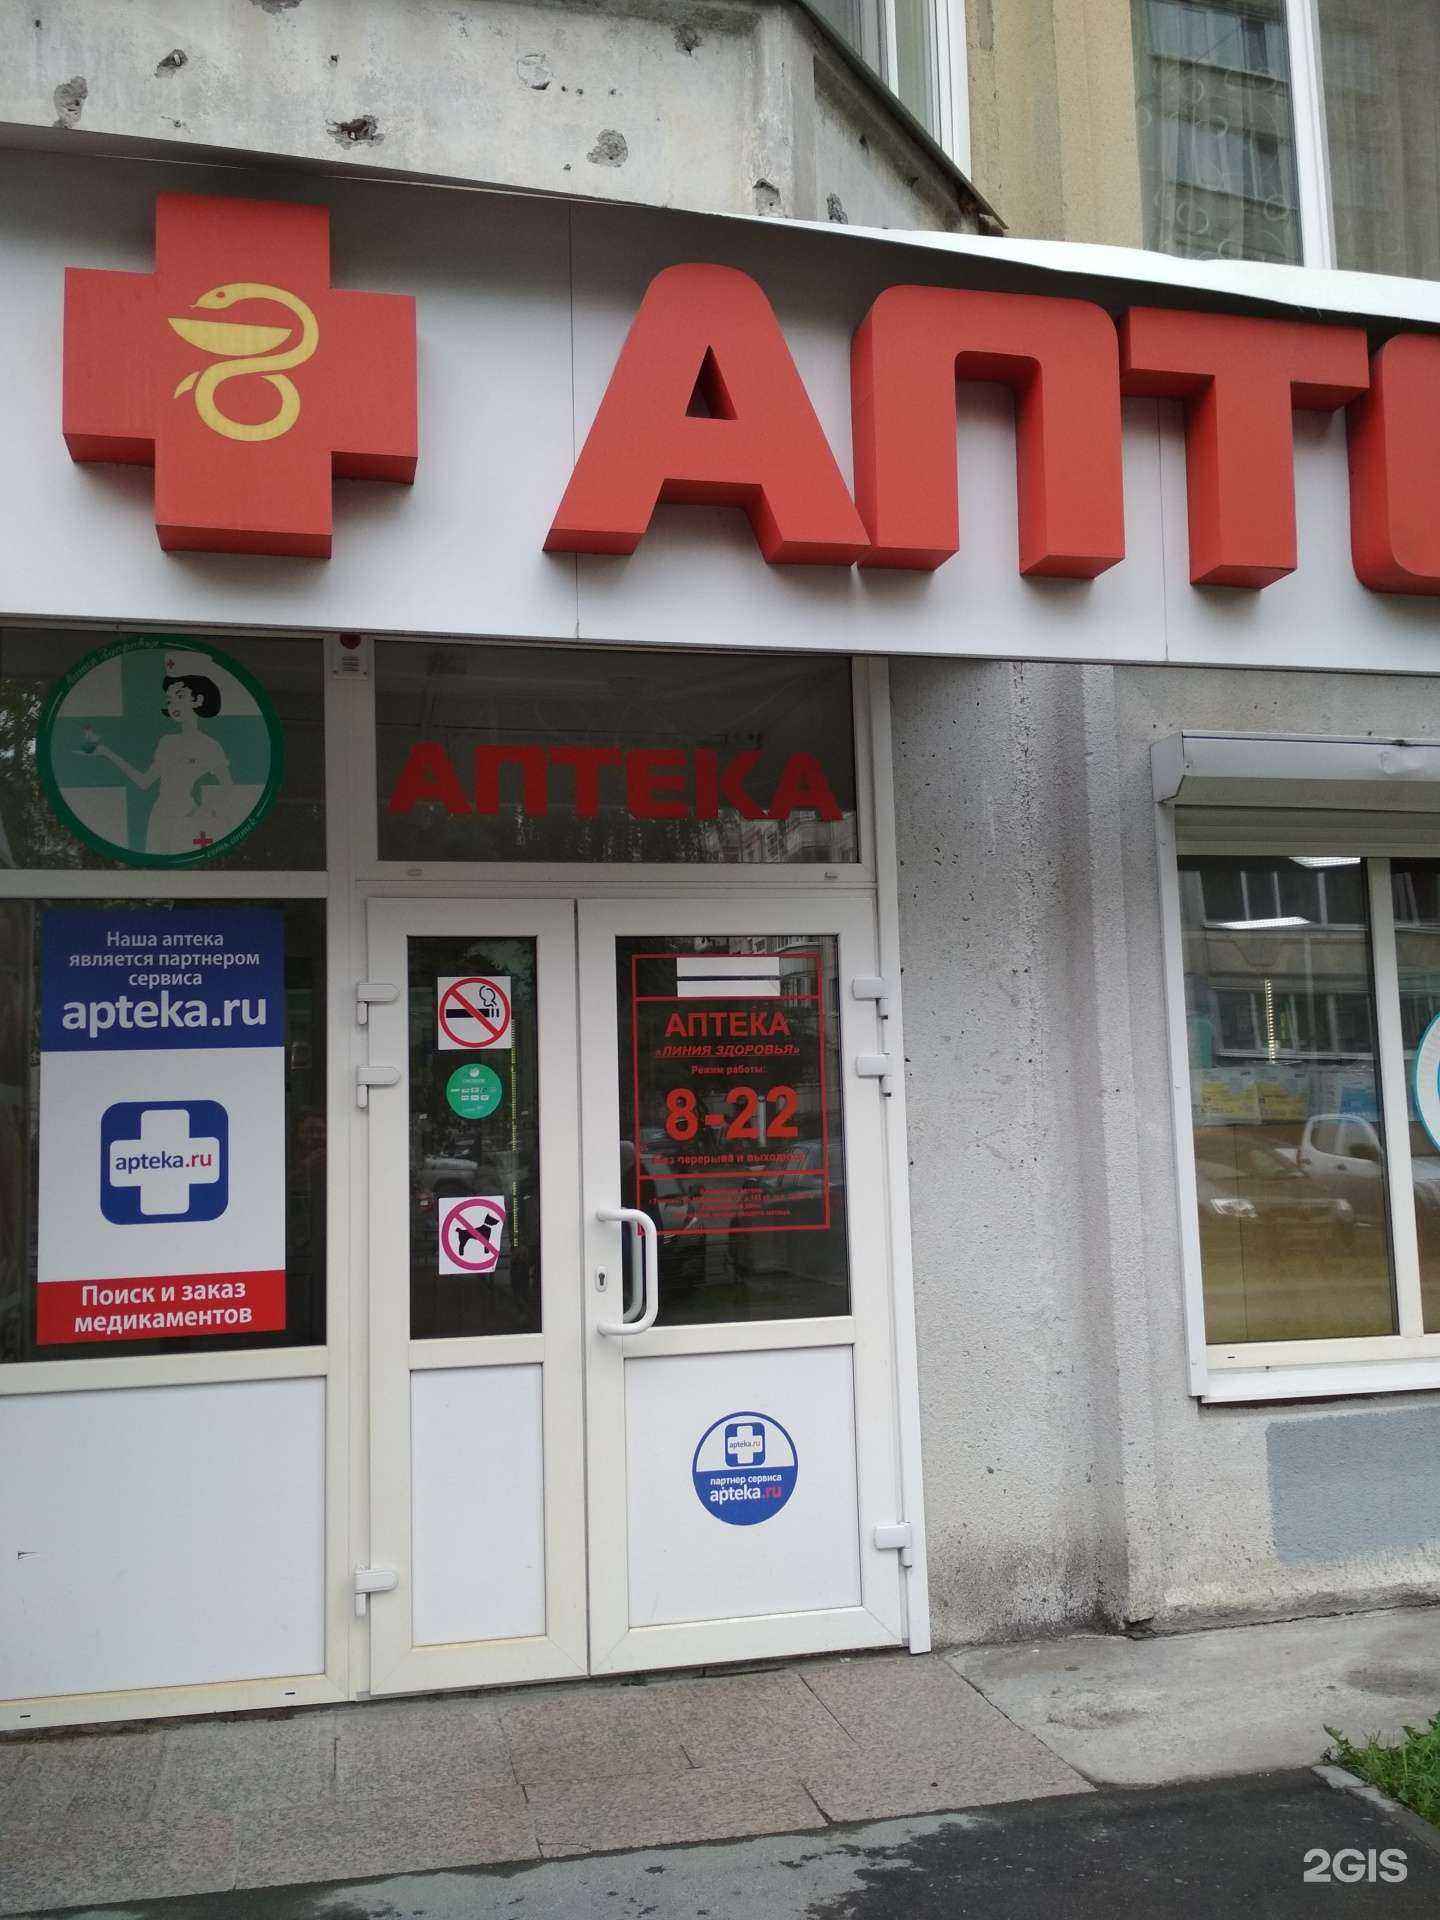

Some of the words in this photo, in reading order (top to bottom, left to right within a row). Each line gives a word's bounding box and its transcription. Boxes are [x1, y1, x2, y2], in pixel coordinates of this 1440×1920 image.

[387, 740, 844, 822] АПТЕКА
[106, 932, 157, 947] Наша
[162, 935, 224, 946] аптека
[69, 953, 153, 967] является
[158, 953, 260, 969] партнером
[128, 973, 202, 989] сервиса
[61, 990, 267, 1038] apteka.ru
[664, 1011, 791, 1037] АПТЕКА
[665, 1086, 798, 1141] 8-22
[115, 1152, 212, 1175] apteka.ru
[82, 1285, 155, 1306] Поиск
[161, 1286, 175, 1302] и
[181, 1282, 246, 1301] заказ
[74, 1307, 252, 1334] медикаментов
[729, 1439, 761, 1449] apteka.ru
[710, 1476, 746, 1487] партнер
[748, 1474, 782, 1484] сервиса
[710, 1484, 782, 1505] apteka.ru
